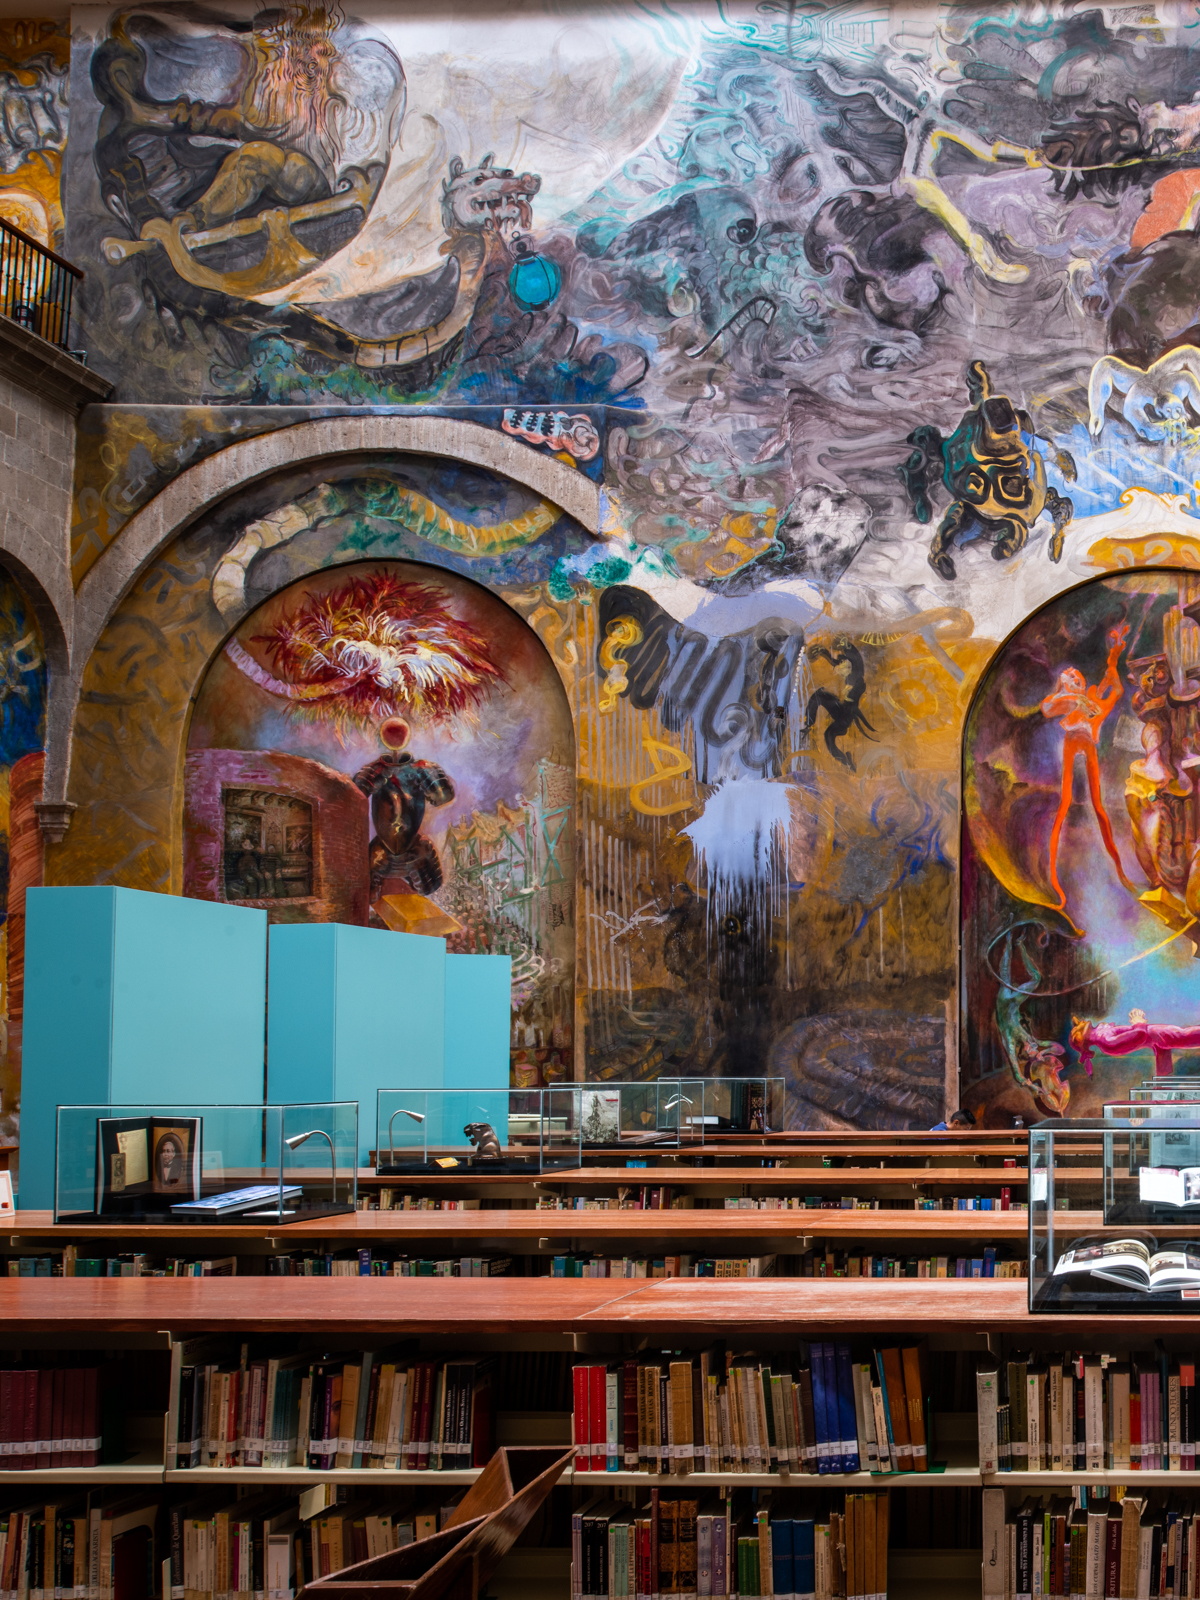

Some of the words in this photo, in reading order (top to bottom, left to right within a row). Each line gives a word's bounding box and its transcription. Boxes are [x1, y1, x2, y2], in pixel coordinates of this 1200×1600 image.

[172, 1512, 180, 1540] Querétaro
[173, 1550, 181, 1584] Gobernantes
[715, 1580, 723, 1594] VILLA
